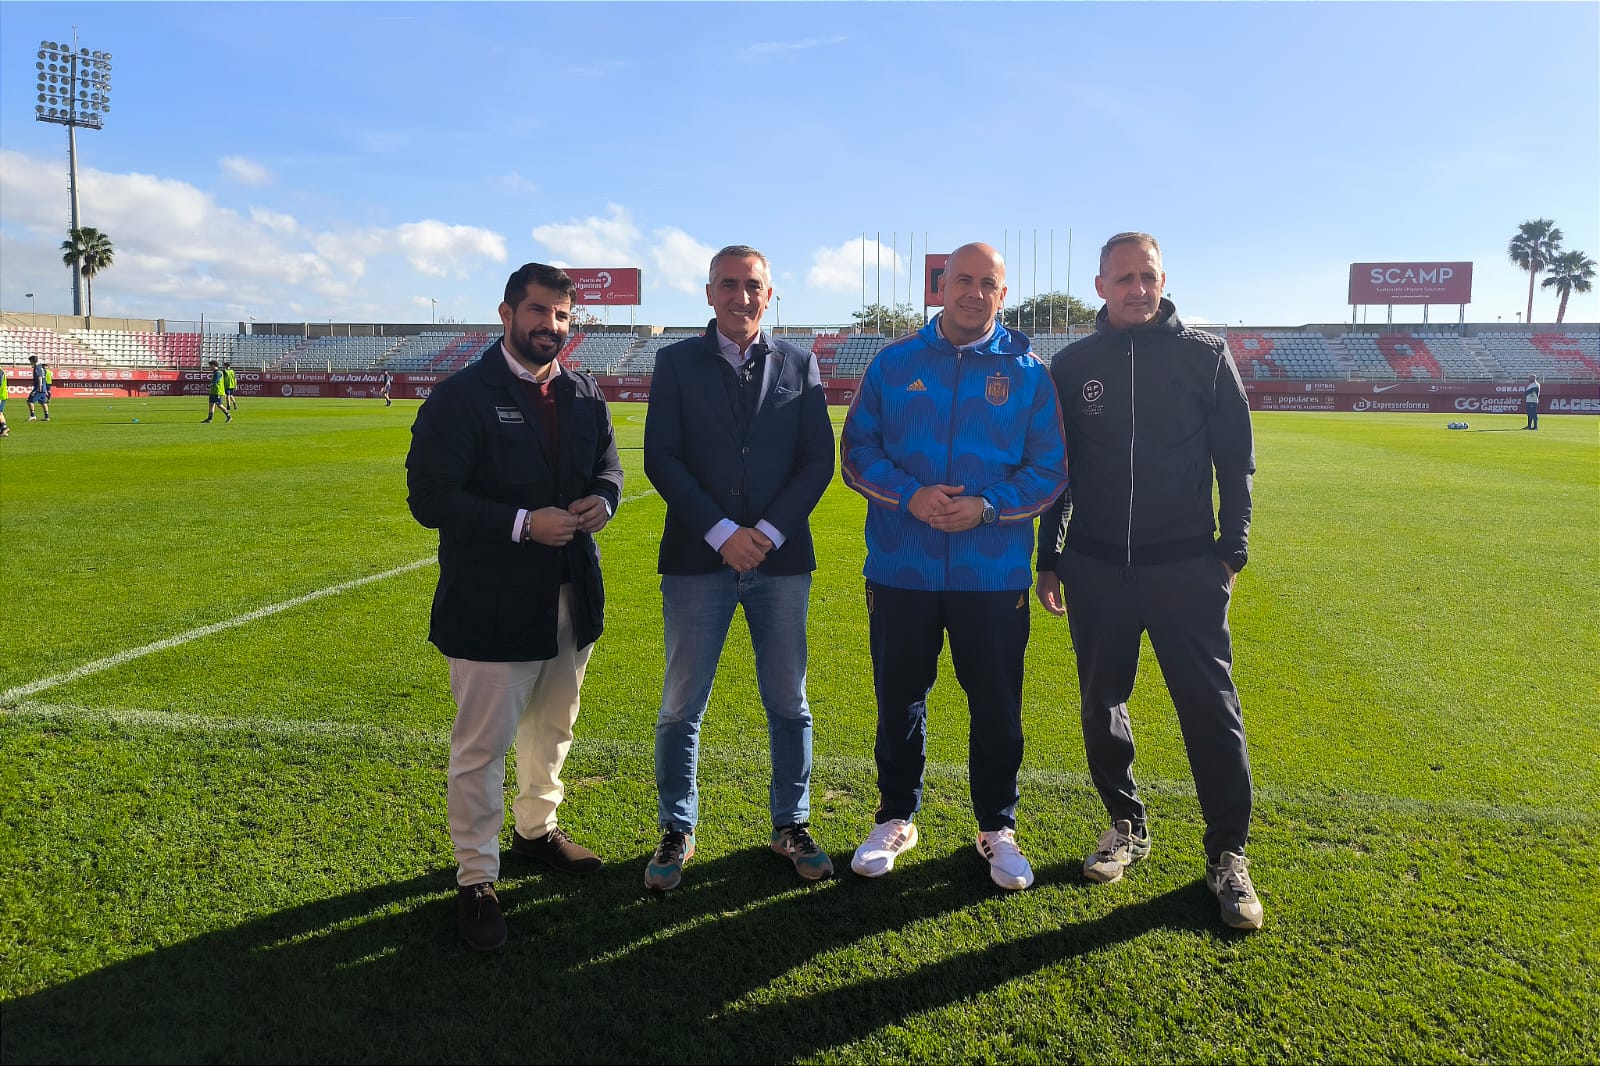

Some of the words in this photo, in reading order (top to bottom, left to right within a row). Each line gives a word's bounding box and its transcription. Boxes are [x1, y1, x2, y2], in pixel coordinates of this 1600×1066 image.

[1370, 267, 1453, 284] SCAMP
[330, 374, 346, 382] AON
[346, 374, 361, 382] AON
[362, 374, 378, 382] AON
[147, 383, 172, 391] caser
[1278, 395, 1319, 404] populares
[1372, 400, 1430, 409] Expressreformas
